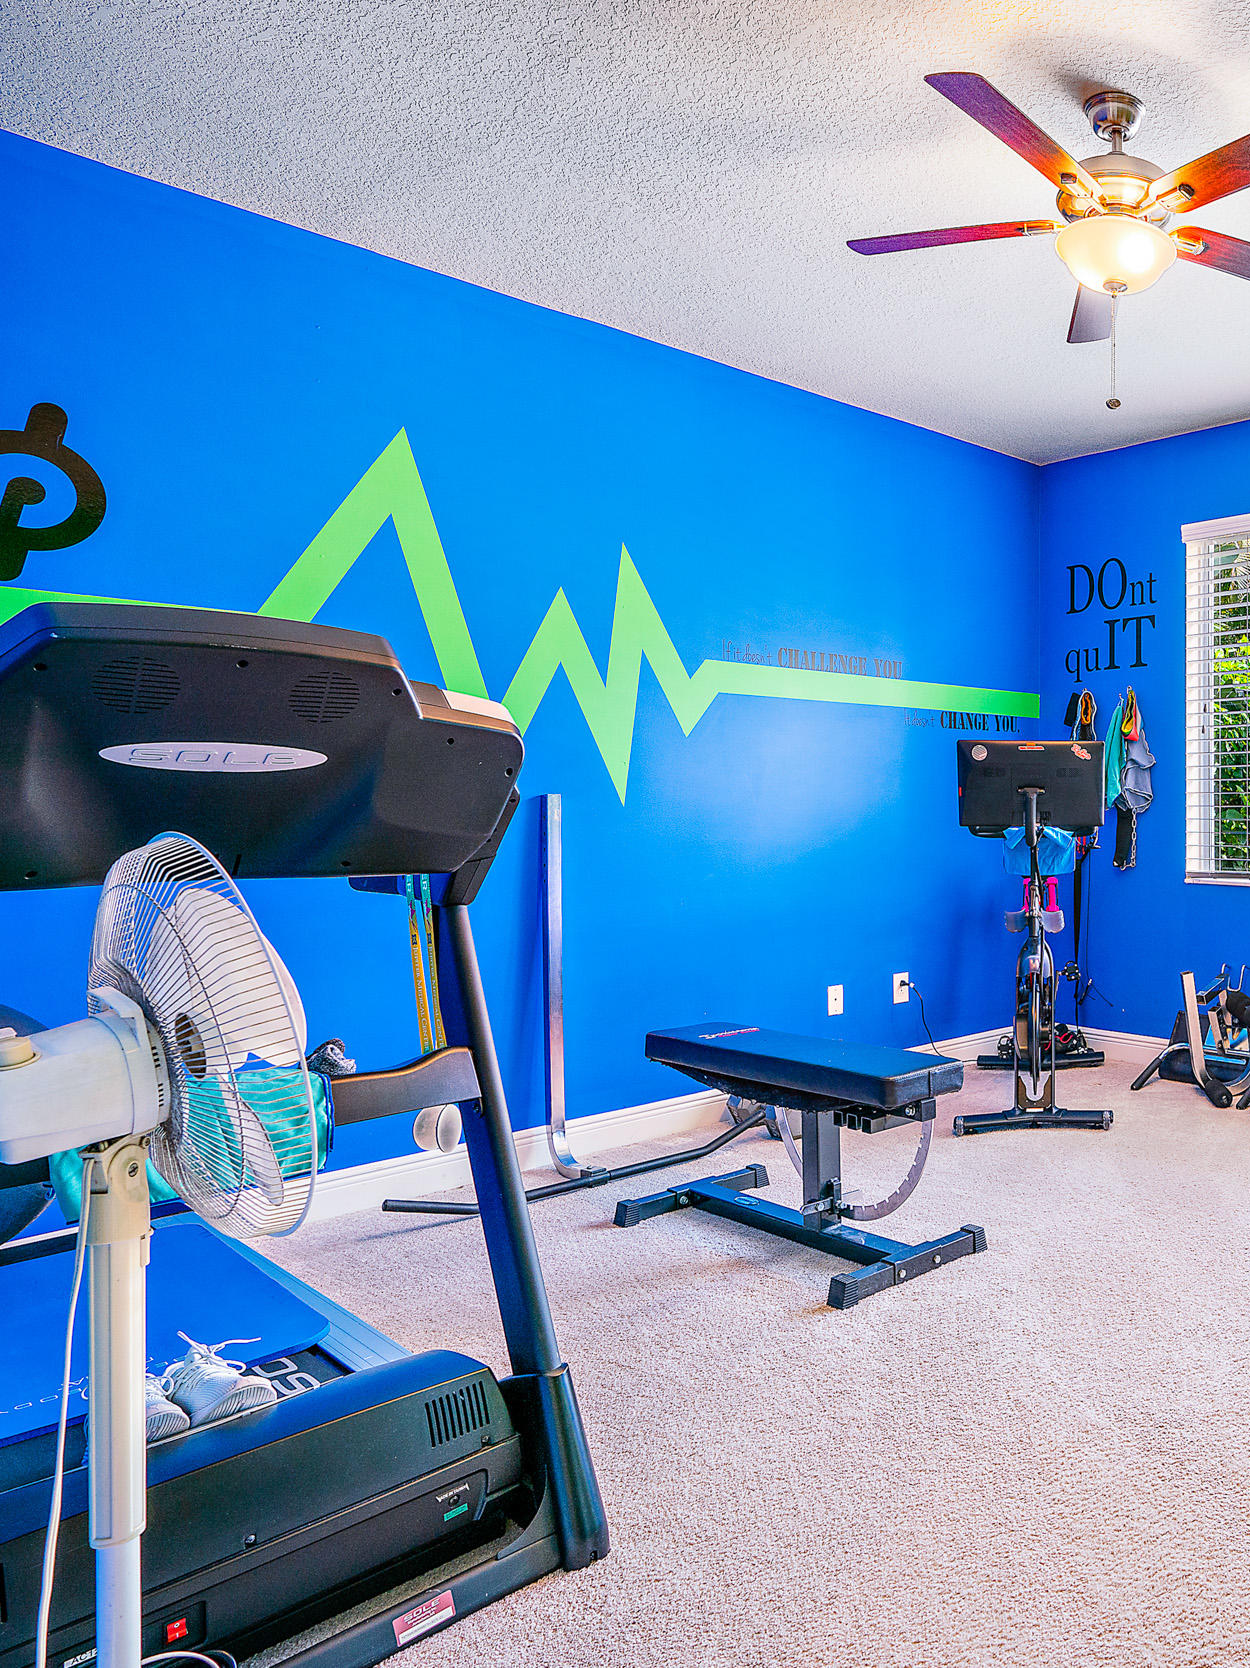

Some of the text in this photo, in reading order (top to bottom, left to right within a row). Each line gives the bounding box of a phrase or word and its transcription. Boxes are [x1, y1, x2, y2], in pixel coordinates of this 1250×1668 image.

[1066, 557, 1158, 614] DOnt
[777, 647, 867, 676] CHALLENGE
[873, 658, 903, 680] YOU
[1065, 614, 1156, 683] quIT
[941, 711, 989, 731] CHANGE
[994, 714, 1020, 733] YOU.
[128, 747, 302, 766] SOLE
[415, 979, 425, 1017] MEDICAL
[403, 1597, 441, 1622] SOLE
